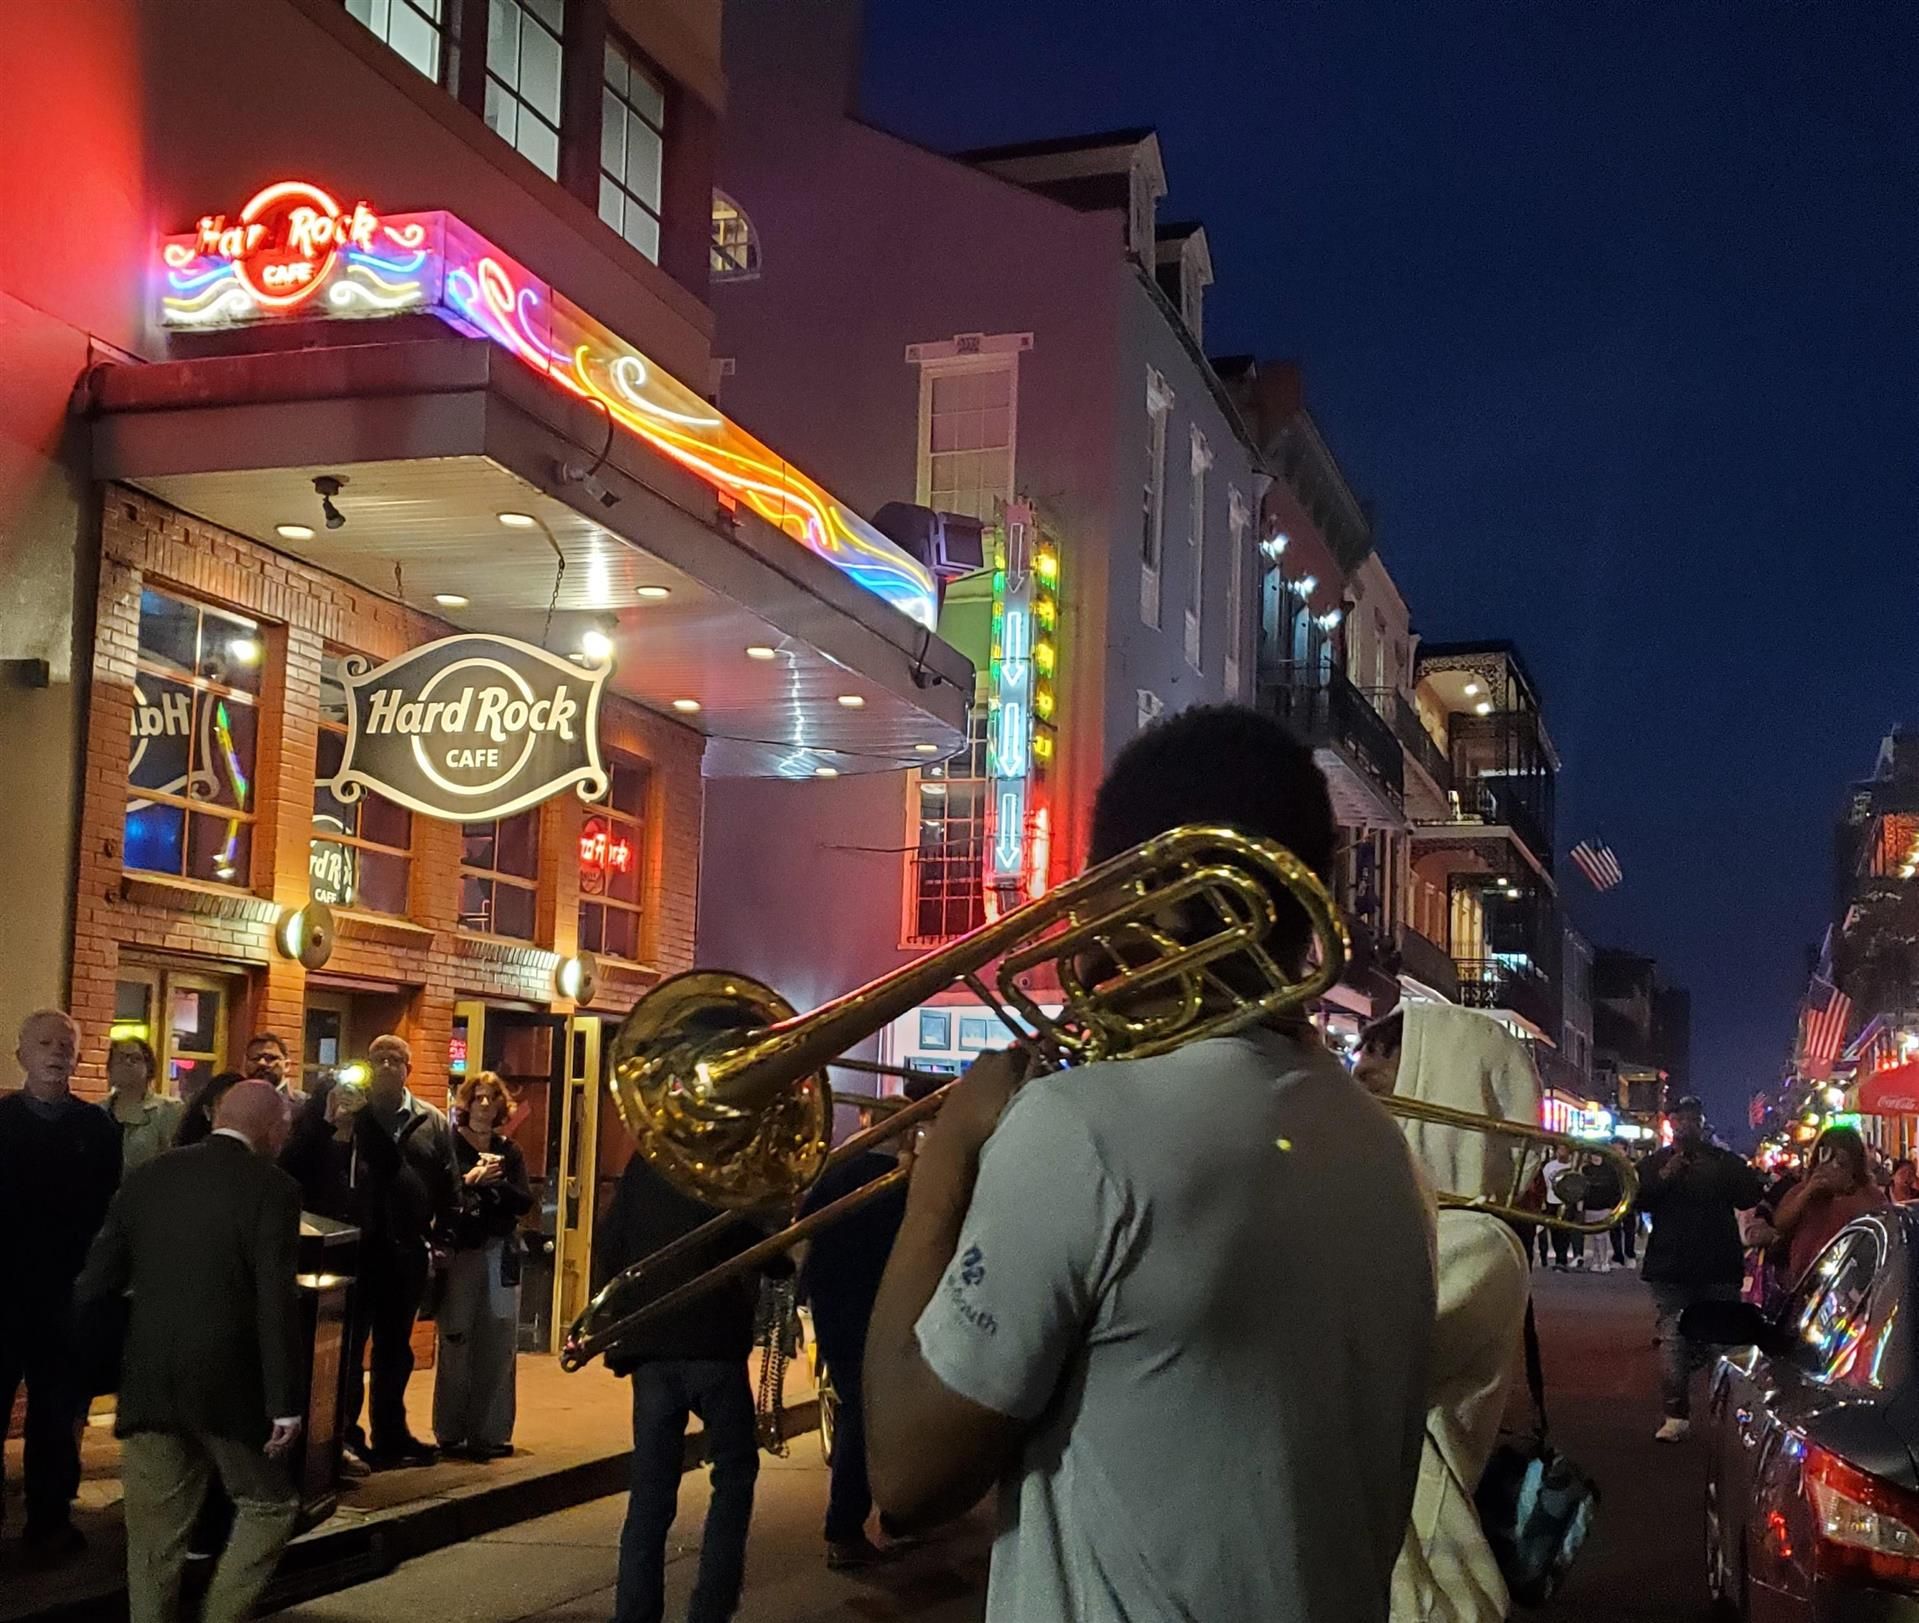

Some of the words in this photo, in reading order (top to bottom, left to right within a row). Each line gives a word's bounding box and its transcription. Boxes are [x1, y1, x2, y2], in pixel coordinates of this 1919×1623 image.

[289, 201, 378, 258] Rock
[262, 262, 314, 286] CAFE
[366, 686, 474, 735] Hard
[475, 685, 577, 742] Rock
[446, 749, 499, 768] CAFE
